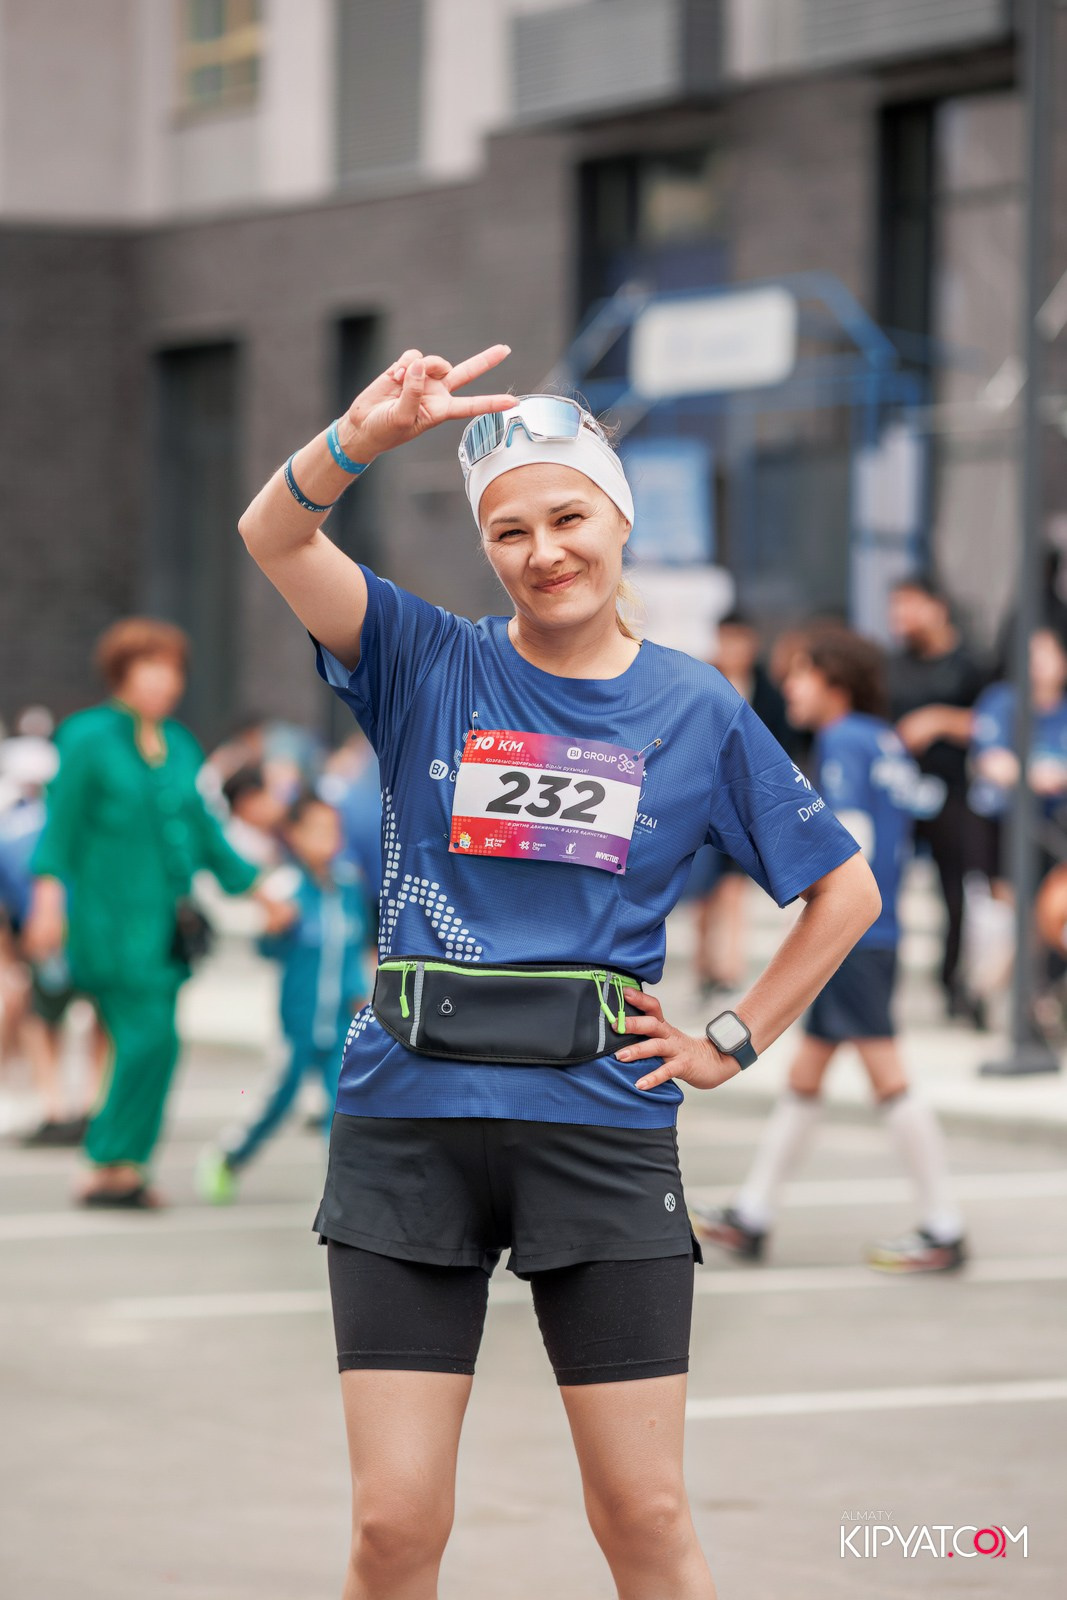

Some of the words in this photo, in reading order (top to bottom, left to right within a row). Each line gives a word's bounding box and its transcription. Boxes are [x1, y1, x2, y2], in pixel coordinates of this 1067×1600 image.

[473, 736, 495, 750] 10
[583, 751, 617, 764] GROUP
[430, 761, 447, 778] BI
[485, 771, 606, 824] 232
[595, 851, 619, 864] INVICTUS
